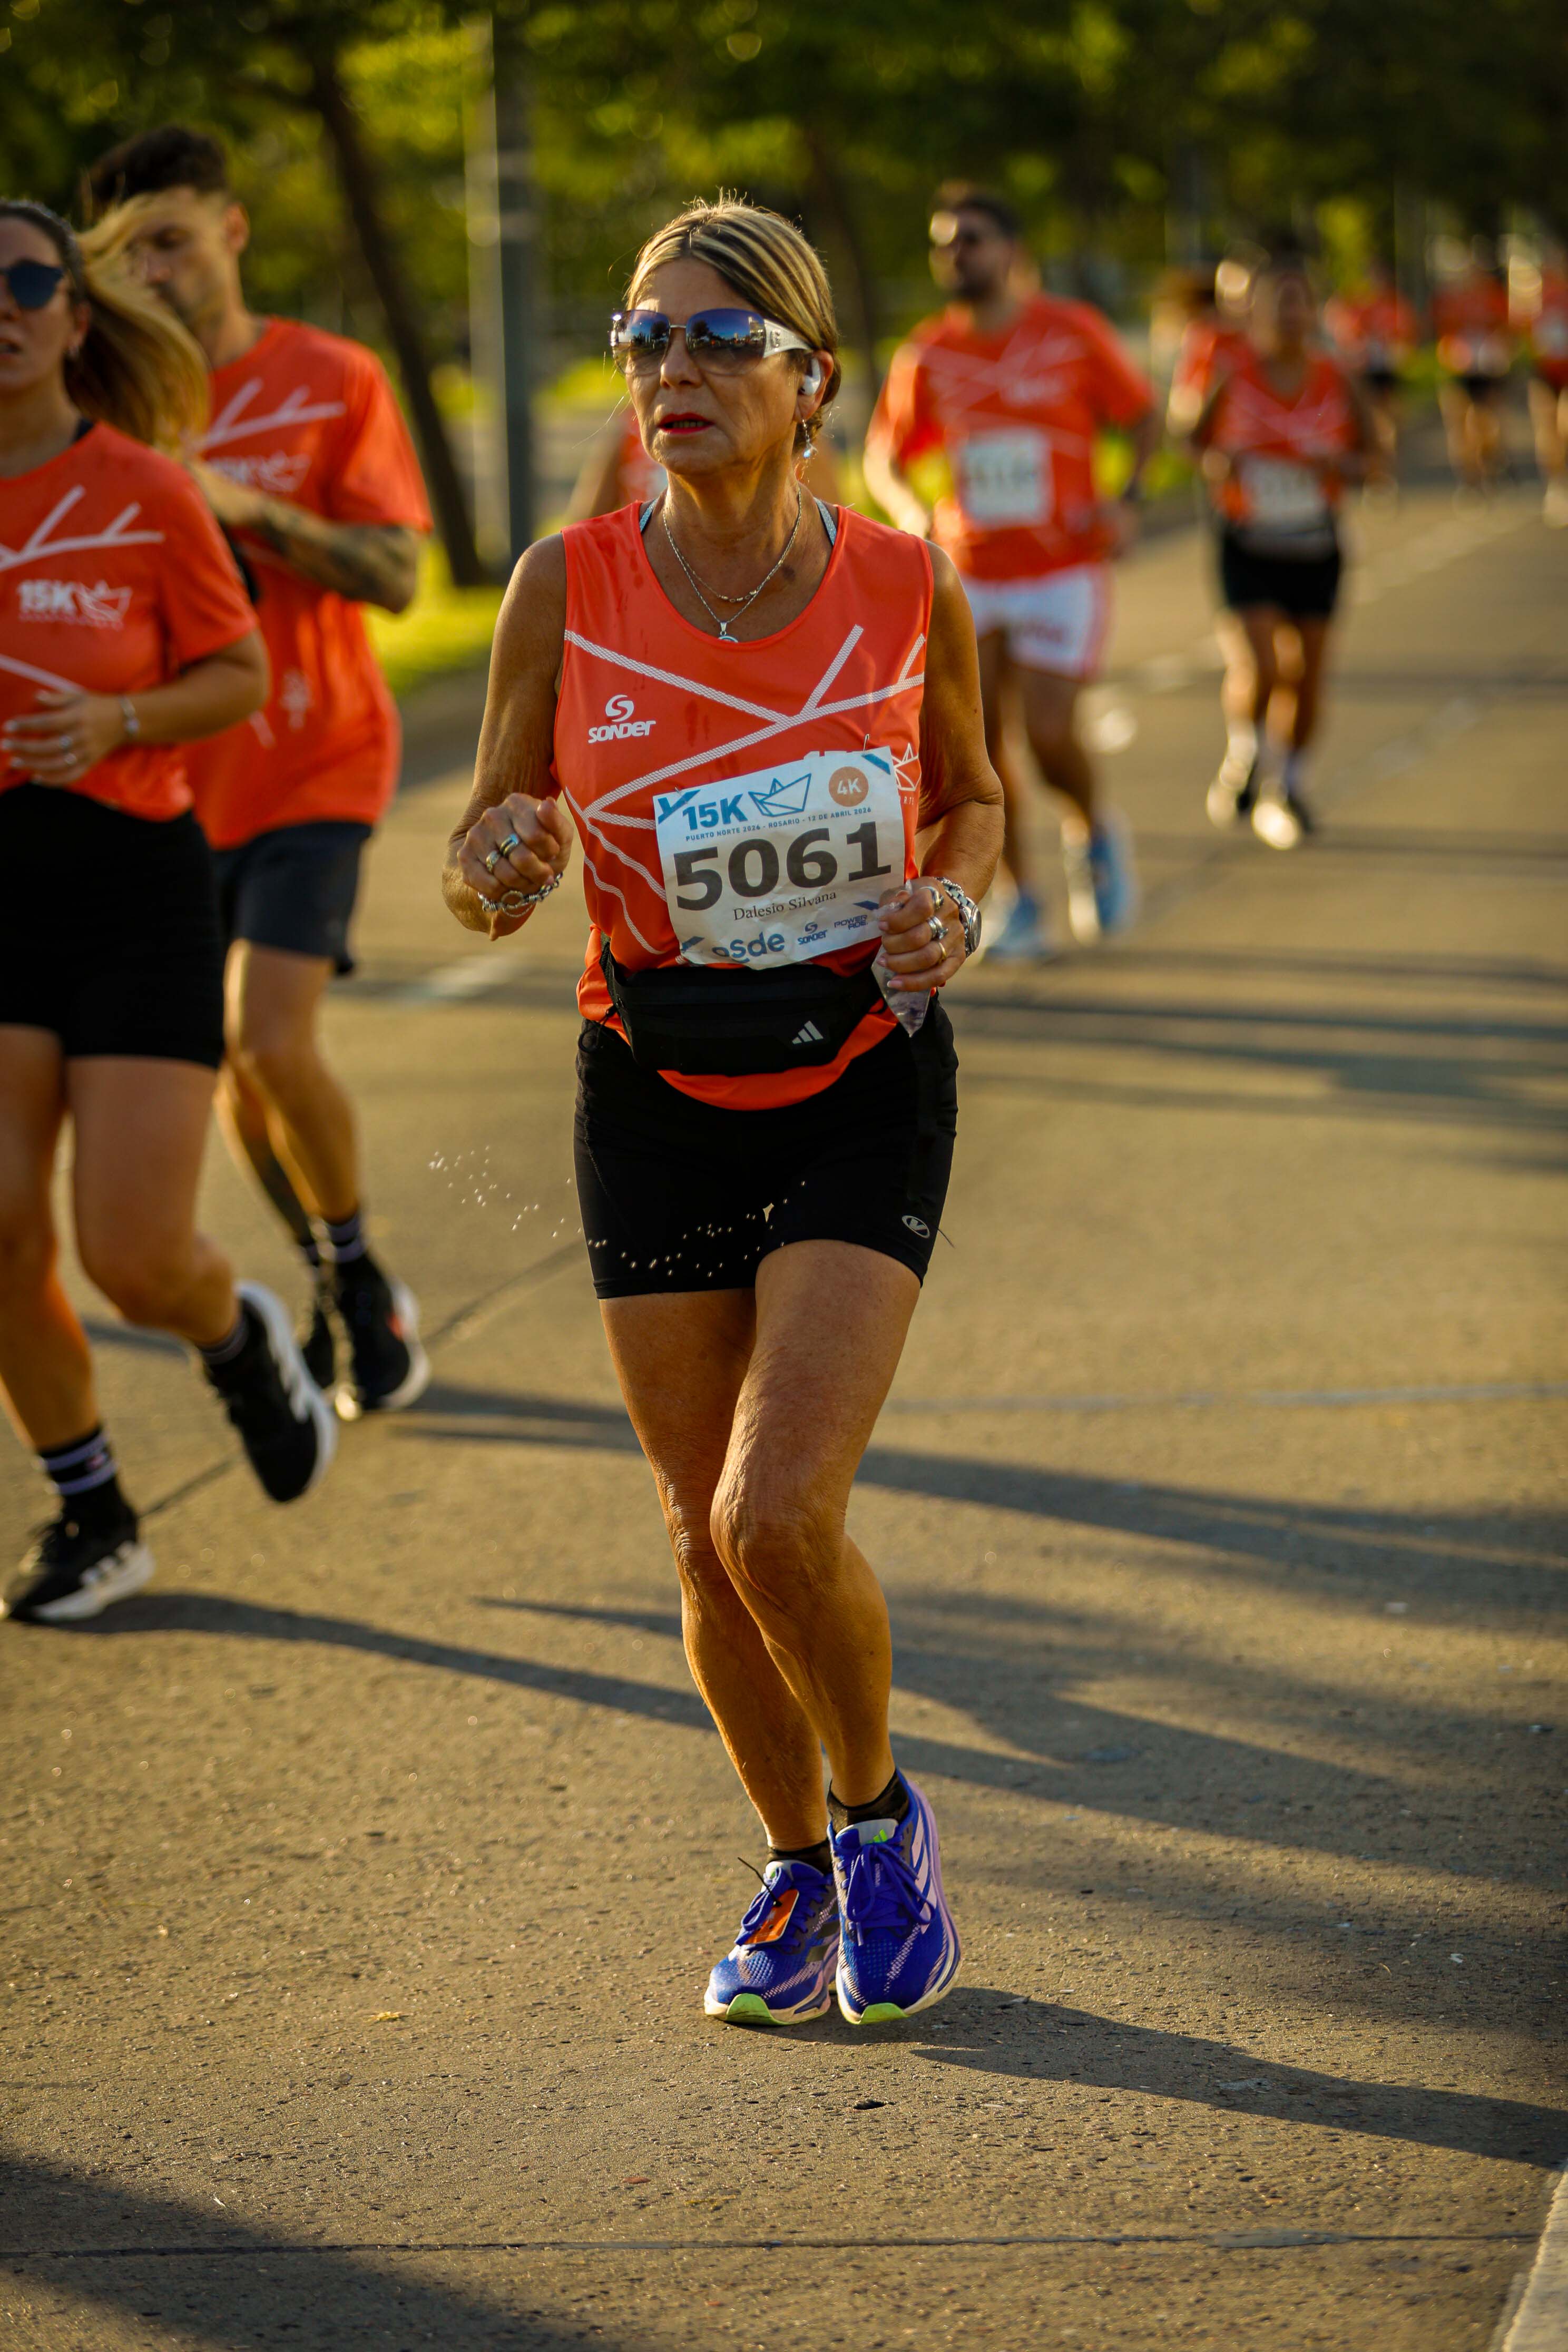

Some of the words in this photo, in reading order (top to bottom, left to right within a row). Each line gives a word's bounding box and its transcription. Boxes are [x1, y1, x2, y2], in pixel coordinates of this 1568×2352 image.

[837, 778, 862, 795] 4K
[682, 793, 748, 831] 15K
[685, 832, 714, 841] PUERTO
[717, 827, 741, 837] NORTE
[743, 824, 760, 832] 2026
[768, 818, 800, 829] ROSARIO
[830, 810, 851, 819] ABRIL
[854, 807, 872, 815] 2026
[673, 821, 891, 911] 5061
[733, 903, 785, 921] Dalesio
[788, 892, 837, 908] Silvana
[834, 915, 868, 928] POWER
